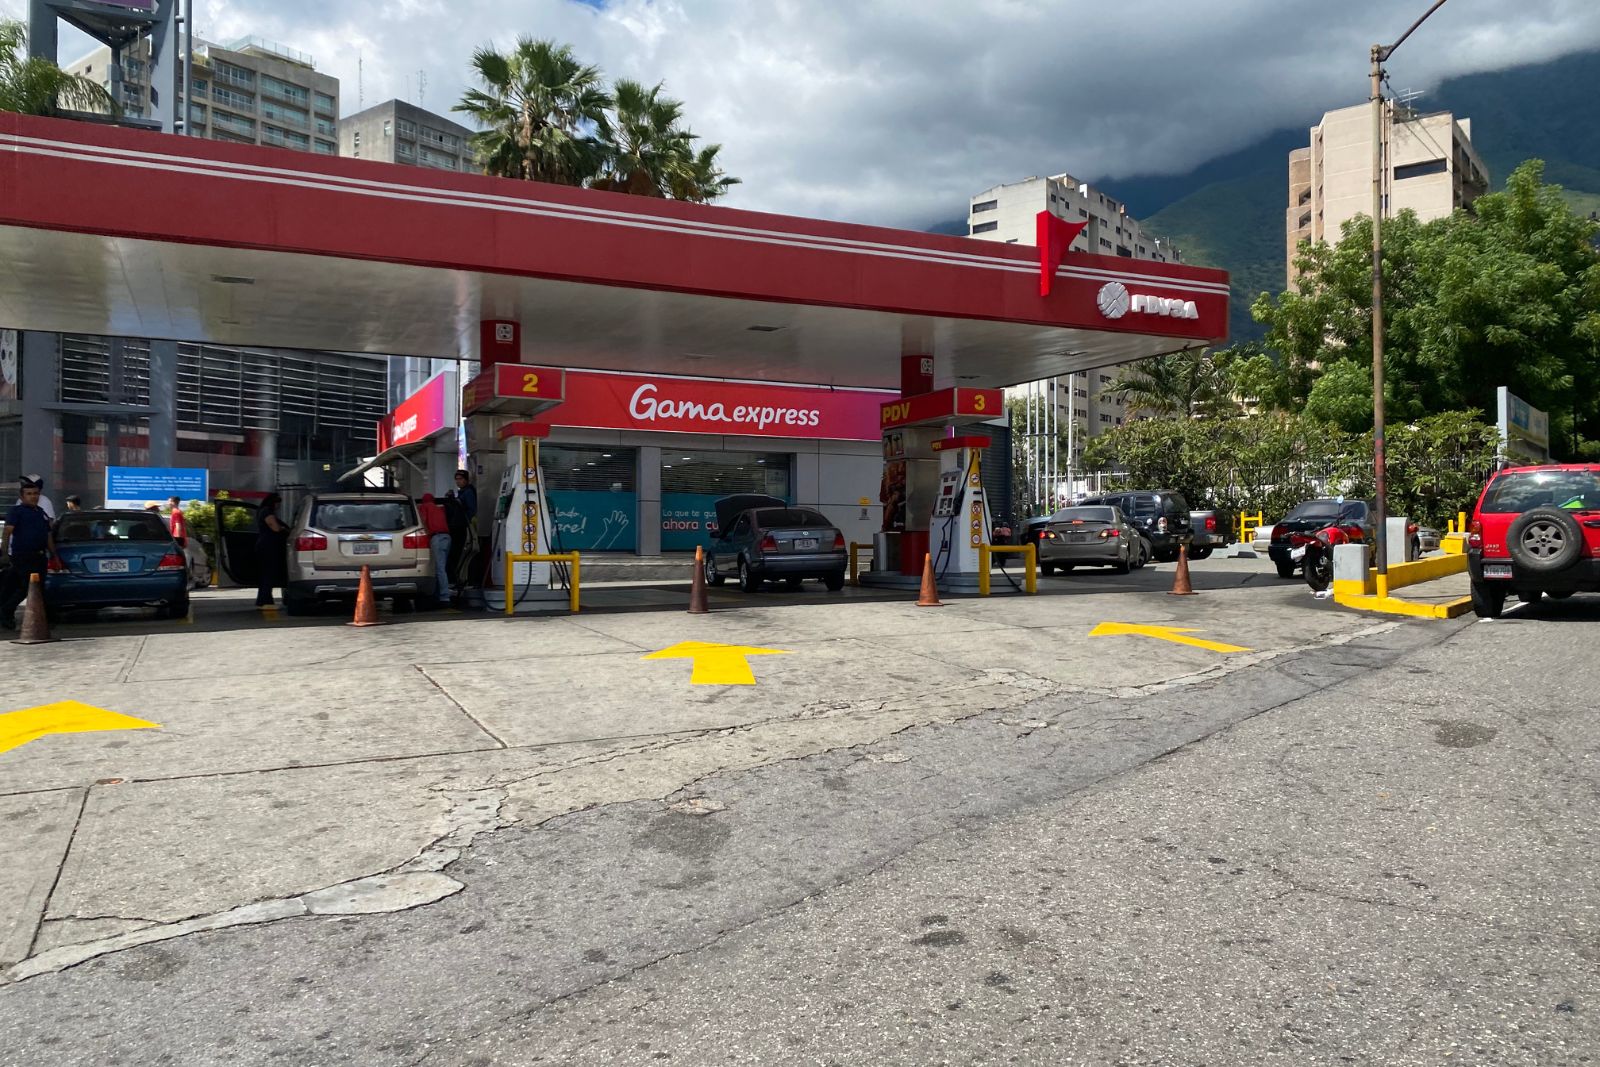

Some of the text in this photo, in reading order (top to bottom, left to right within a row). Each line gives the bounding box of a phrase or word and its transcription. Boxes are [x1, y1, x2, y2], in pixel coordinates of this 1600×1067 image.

[522, 373, 539, 392] 2
[629, 384, 820, 430] Gama express
[974, 394, 986, 411] 3
[882, 402, 911, 423] PDV
[662, 509, 673, 517] Lo
[675, 510, 689, 519] que
[703, 510, 717, 519] gus
[662, 518, 719, 530] ahora cu
